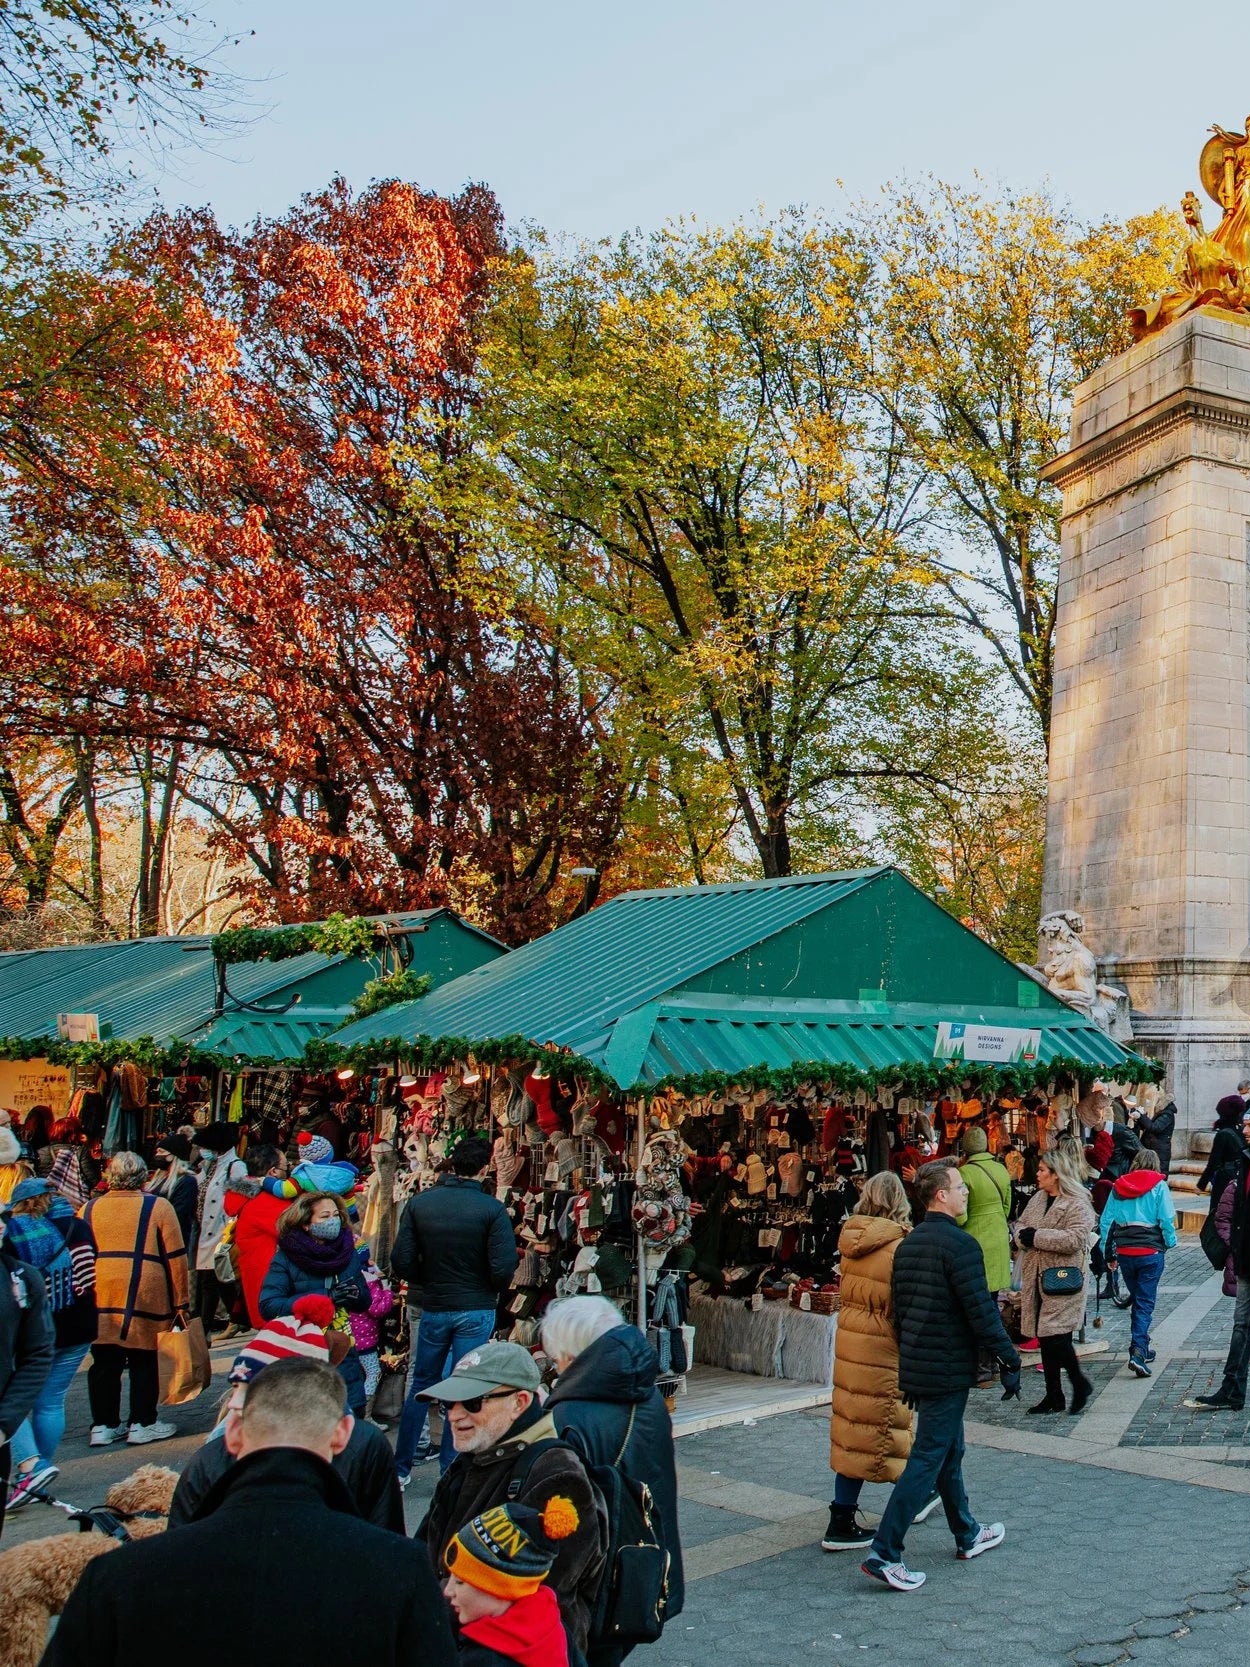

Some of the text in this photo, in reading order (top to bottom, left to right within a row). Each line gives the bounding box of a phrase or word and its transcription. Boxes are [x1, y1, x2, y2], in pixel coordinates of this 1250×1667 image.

[977, 1035, 1004, 1043] NIRVANNA
[473, 1517, 500, 1554] UINS
[481, 1507, 529, 1558] STON
